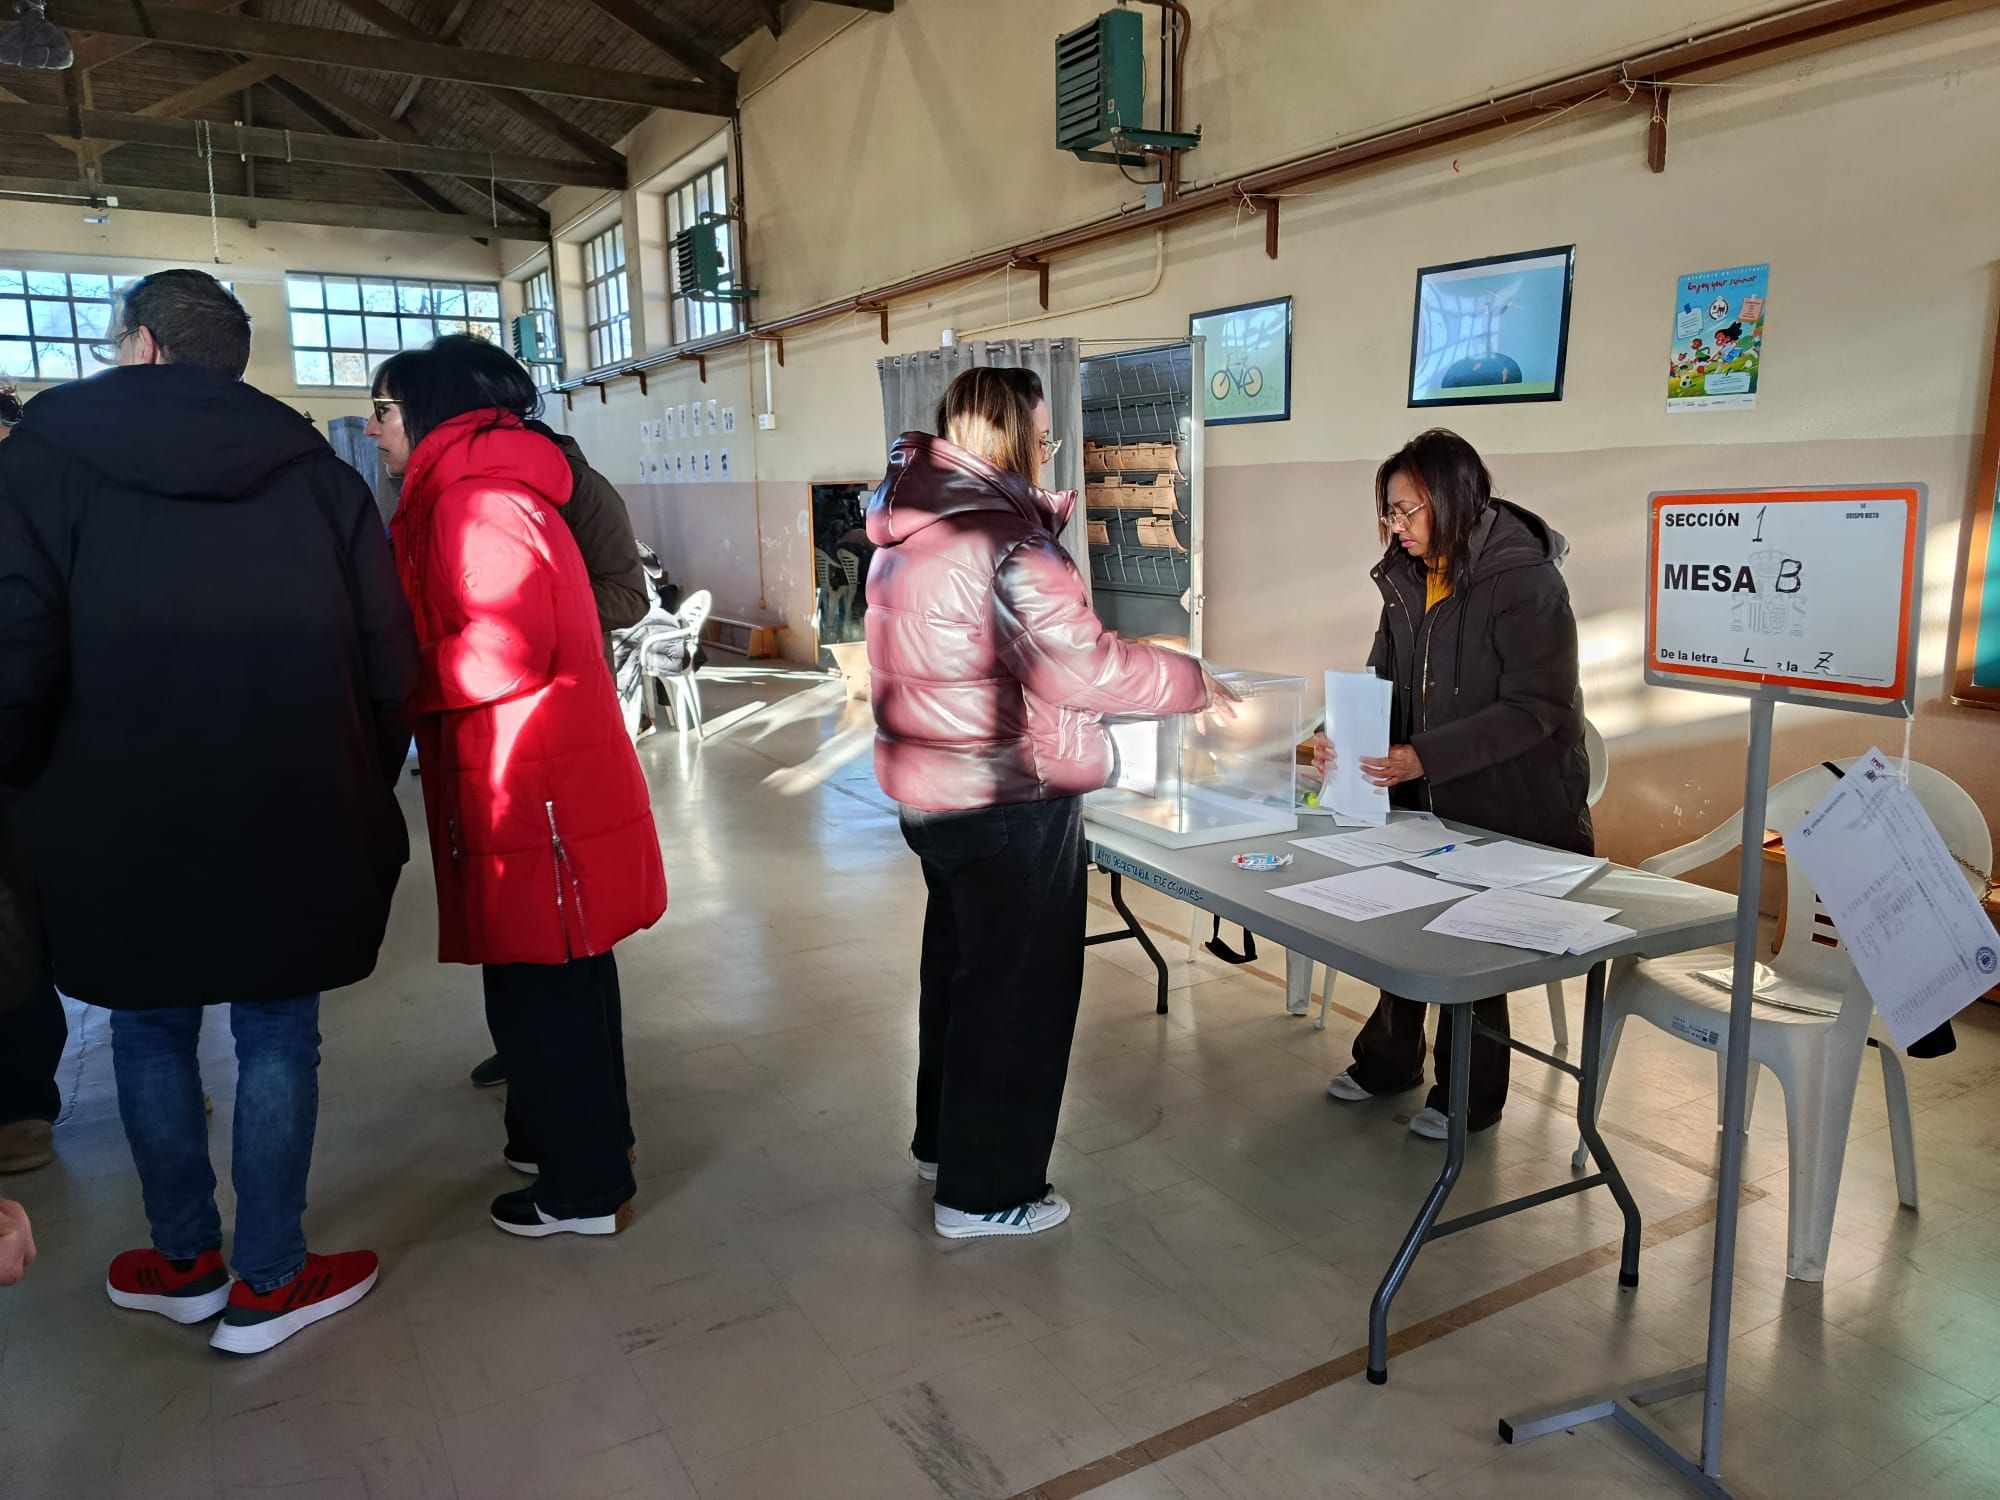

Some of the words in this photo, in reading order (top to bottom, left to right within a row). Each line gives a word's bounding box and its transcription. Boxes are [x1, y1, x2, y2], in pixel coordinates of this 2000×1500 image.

[1711, 279, 1728, 292] your
[1665, 509, 1740, 527] SECCIÓN
[1752, 505, 1767, 542] 1
[1664, 564, 1757, 594] MESA
[1775, 558, 1802, 593] B
[1661, 648, 1675, 660] De
[1678, 650, 1688, 661] la
[1691, 651, 1718, 664] letra
[1743, 647, 1755, 663] L
[1786, 661, 1798, 672] la
[1814, 651, 1834, 670] Z
